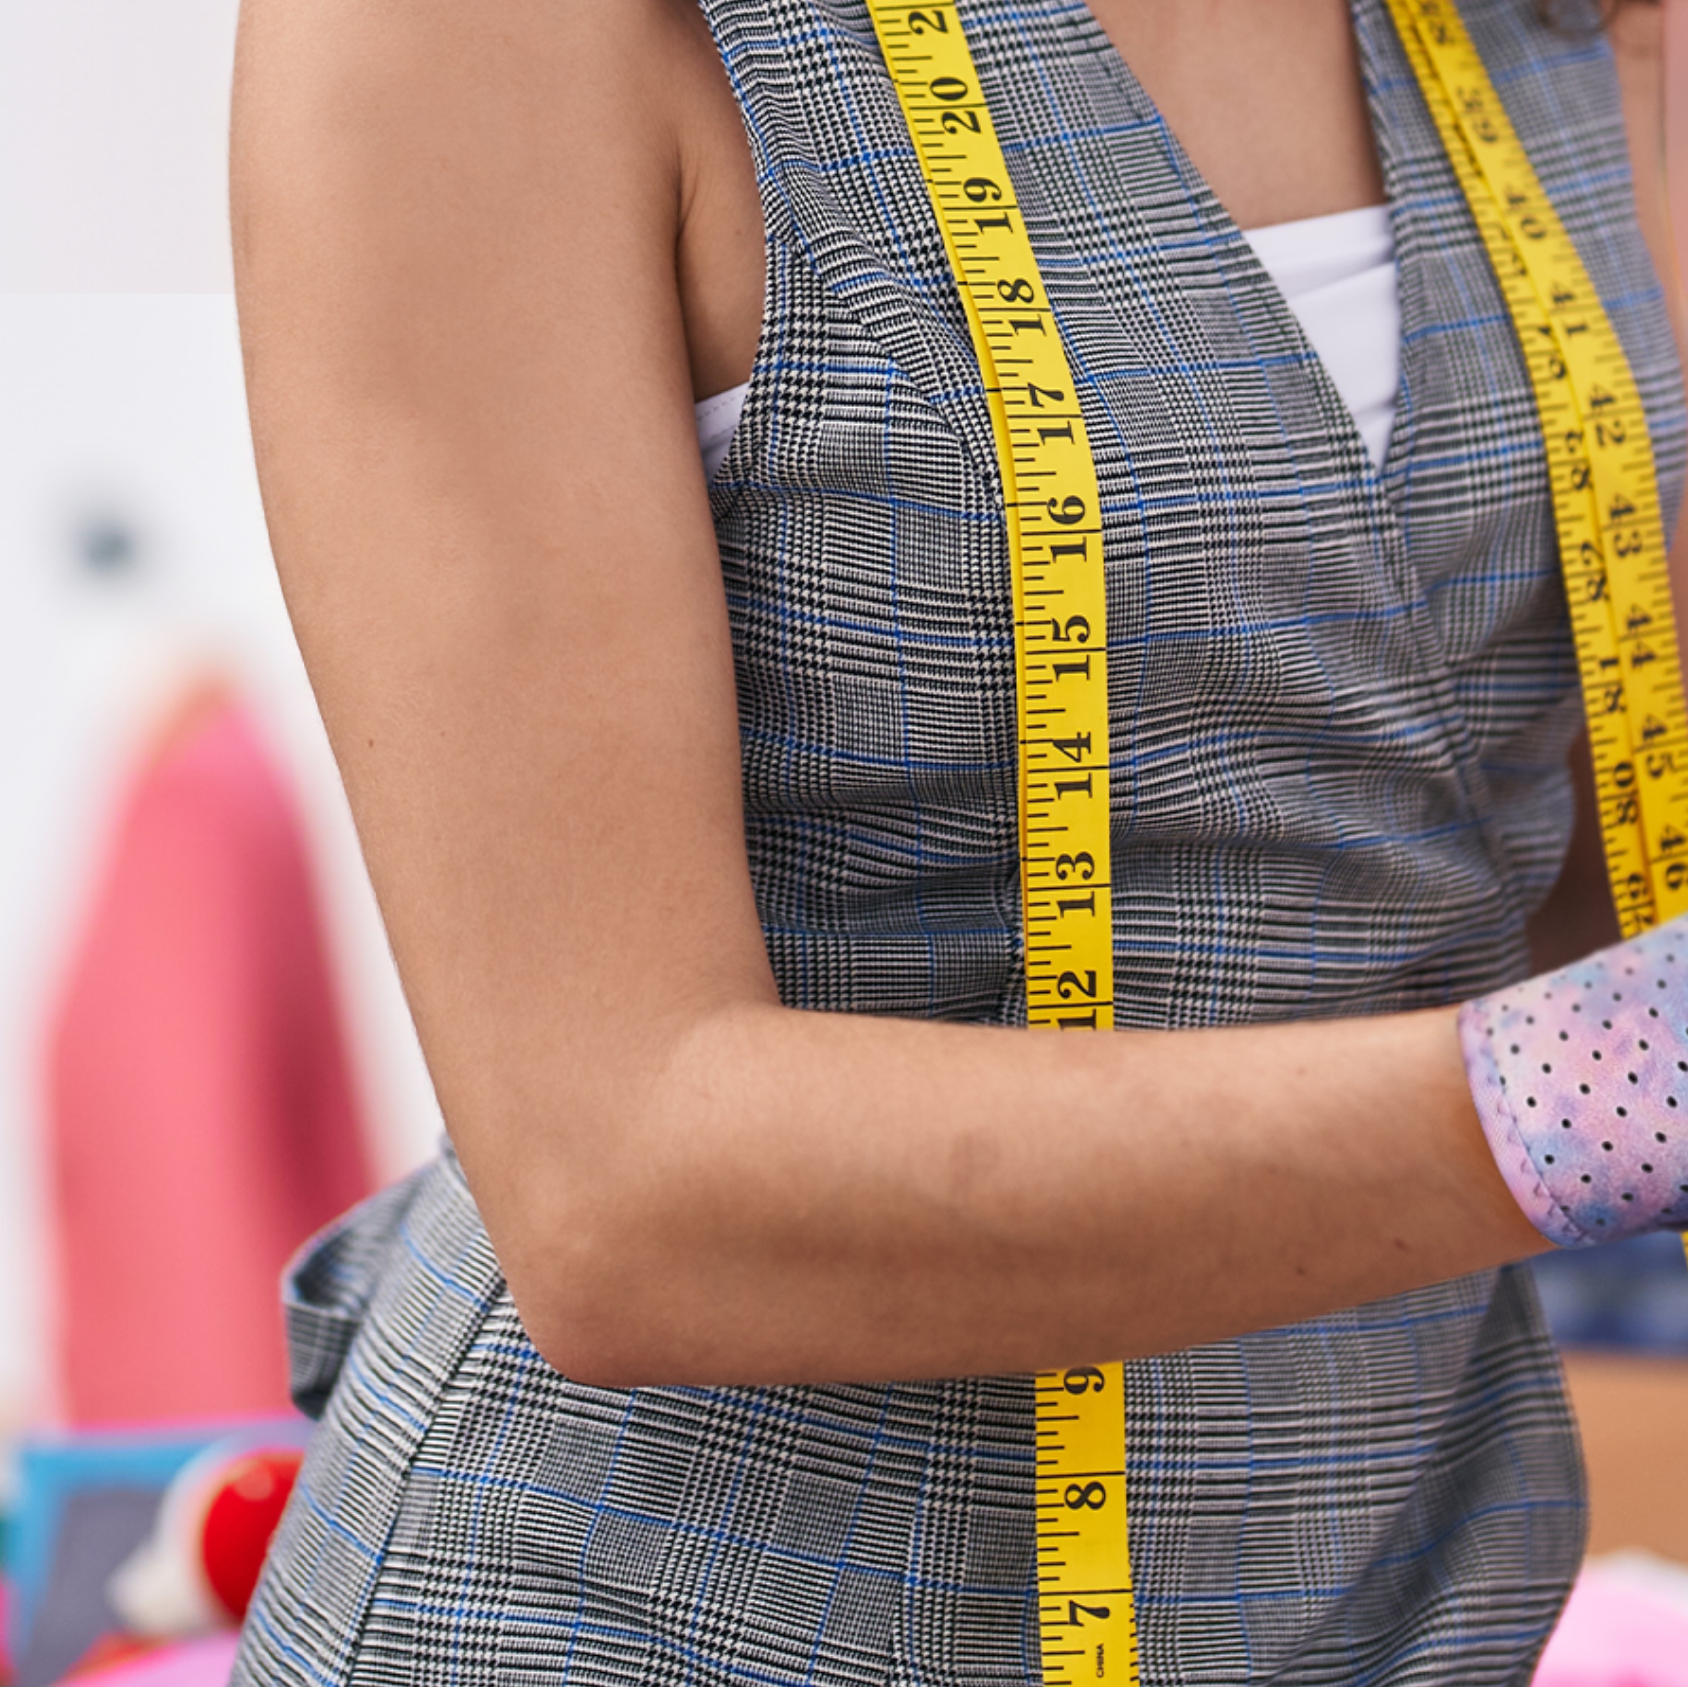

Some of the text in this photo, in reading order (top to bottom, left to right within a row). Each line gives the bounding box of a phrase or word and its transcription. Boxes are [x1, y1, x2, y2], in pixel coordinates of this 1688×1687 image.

[929, 76, 982, 136] 20
[963, 177, 1016, 235] 19
[997, 278, 1047, 337] 18
[1027, 382, 1075, 445] 17
[1504, 184, 1548, 240] 40
[1551, 281, 1591, 339] 41
[1588, 384, 1627, 447] 42
[1608, 493, 1643, 559] 43
[1626, 603, 1658, 670] 44
[1642, 713, 1675, 780] 45
[1047, 495, 1088, 563] 16
[1050, 614, 1091, 682] 15
[1051, 731, 1093, 801] 14
[1055, 851, 1096, 919] 13
[1057, 969, 1097, 1031] 12
[1064, 1481, 1106, 1510] 8
[1068, 1599, 1110, 1628] 7
